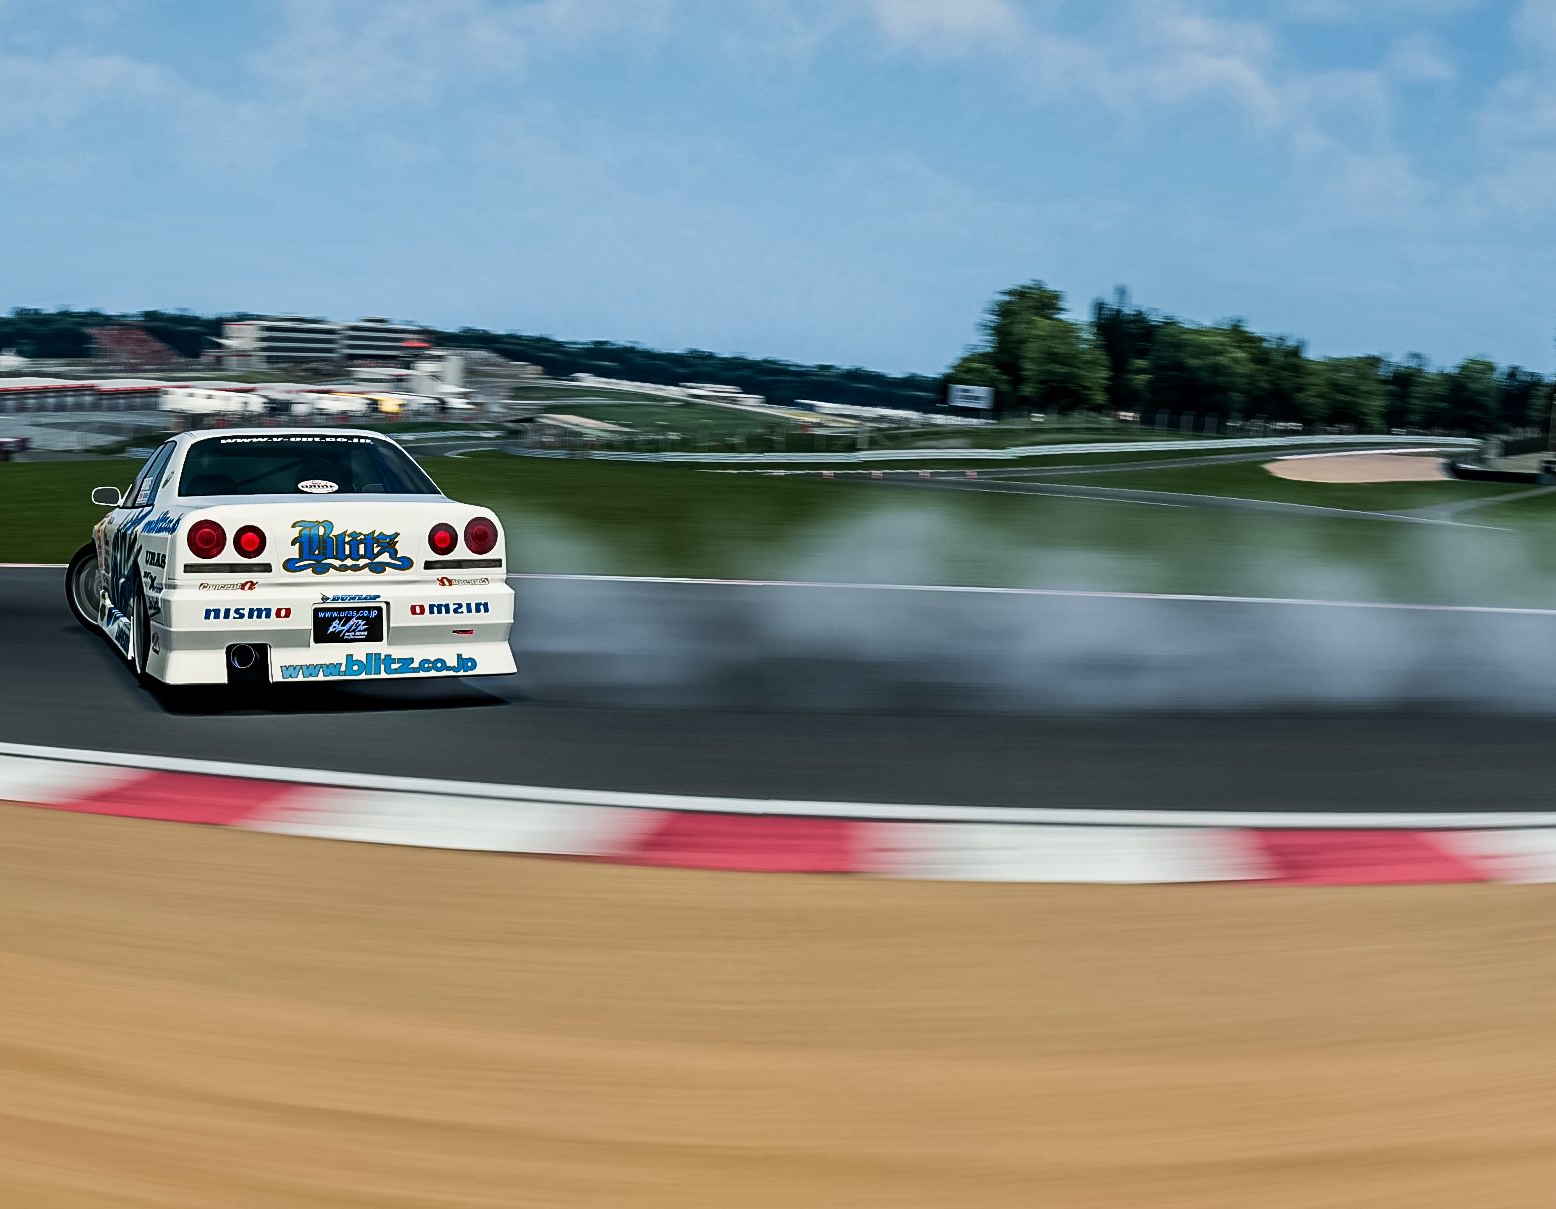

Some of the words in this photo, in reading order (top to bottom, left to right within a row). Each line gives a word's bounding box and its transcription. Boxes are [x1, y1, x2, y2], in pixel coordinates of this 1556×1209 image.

[290, 519, 403, 563] Blitz
[331, 594, 382, 602] DUNLOP
[203, 607, 292, 620] nismo
[318, 608, 378, 619] www.uras.co.jp
[280, 653, 478, 680] www.blitz.co.jp
